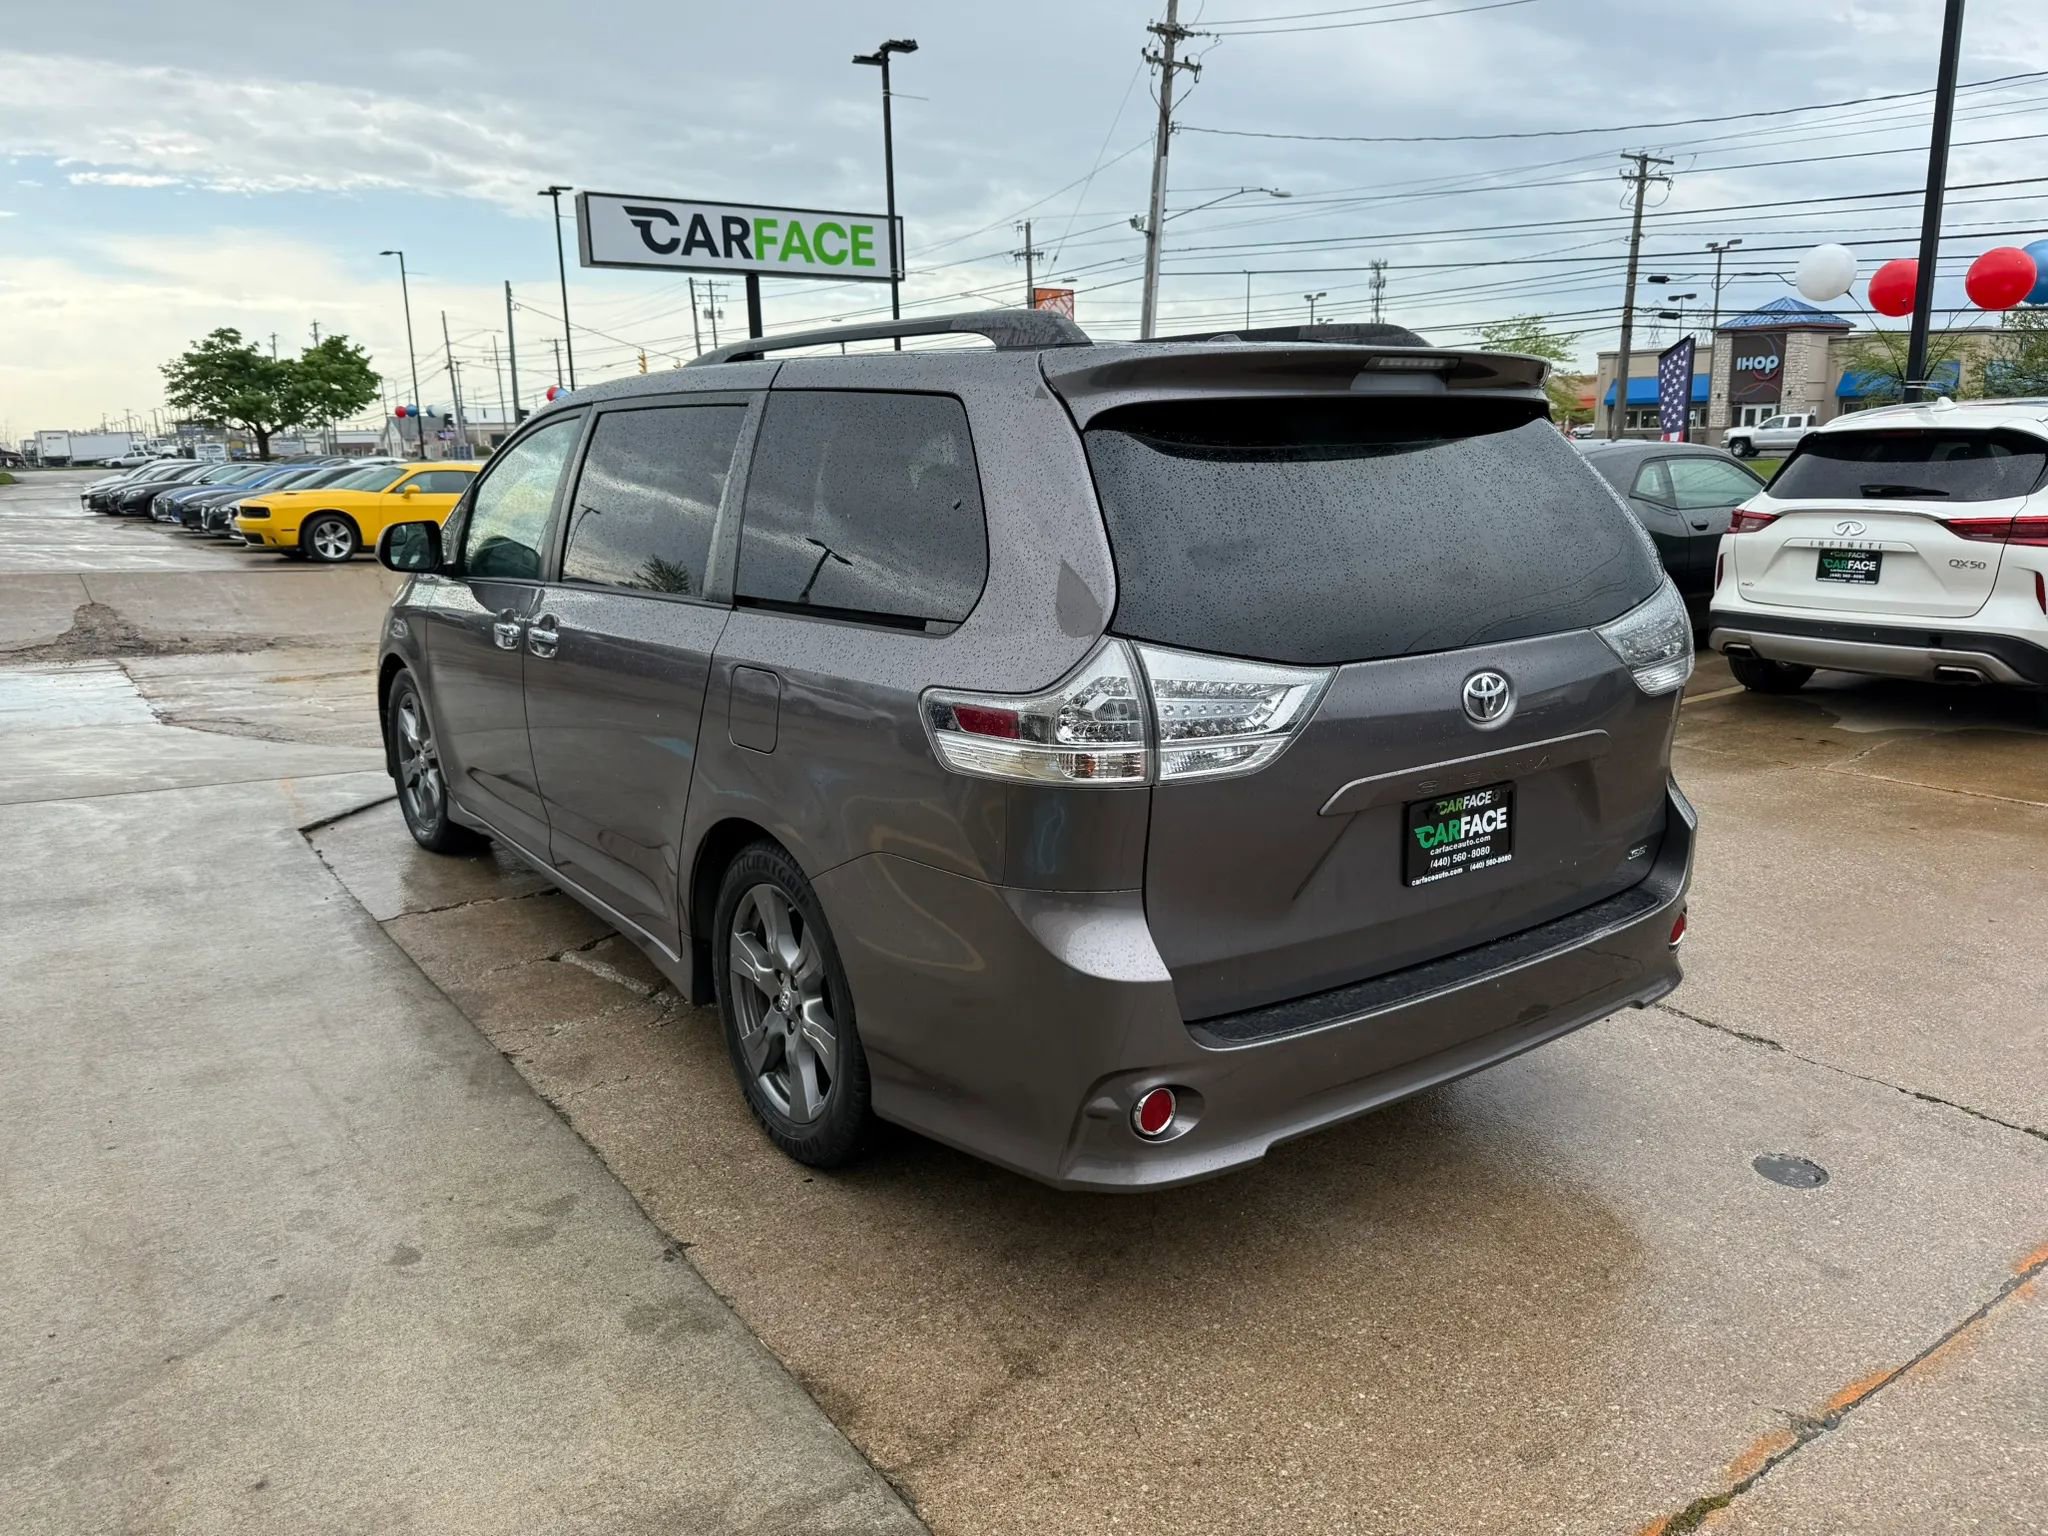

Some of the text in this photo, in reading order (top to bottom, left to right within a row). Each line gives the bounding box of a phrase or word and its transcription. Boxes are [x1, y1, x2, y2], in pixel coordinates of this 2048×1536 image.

[622, 205, 876, 267] CARFACE
[1810, 540, 1883, 550] INFINITI
[1823, 558, 1877, 571] CARFACE
[1948, 558, 1987, 570] QX50
[1416, 753, 1551, 794] SIEA
[1436, 790, 1493, 816] CARFACE
[1413, 806, 1508, 849] CARFACE
[1430, 834, 1491, 855] carfaceauto.com
[1430, 856, 1451, 869] (440)
[1411, 867, 1463, 887] carfaceauto.com
